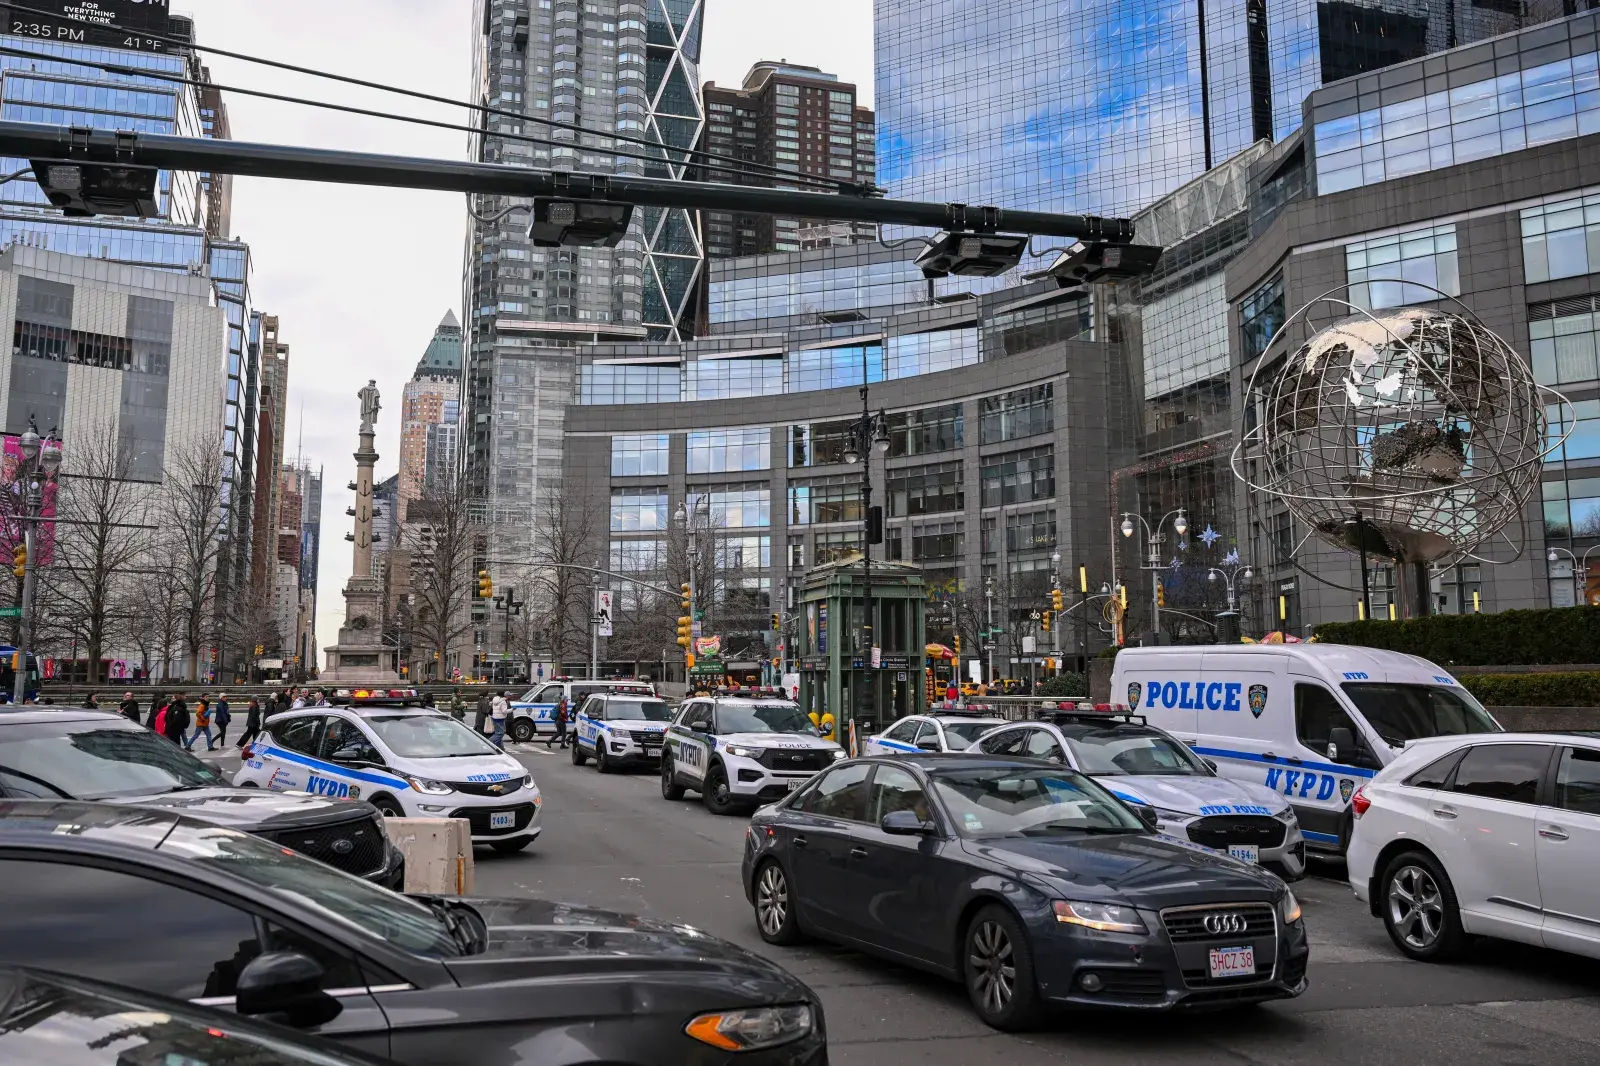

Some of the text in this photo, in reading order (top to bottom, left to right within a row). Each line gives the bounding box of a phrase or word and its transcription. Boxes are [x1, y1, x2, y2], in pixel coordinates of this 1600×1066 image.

[64, 6, 116, 18] EVERYTHING
[68, 13, 111, 24] NEW YORK
[13, 22, 85, 42] 2:35 PM
[123, 37, 140, 48] 41
[1342, 672, 1369, 680] NYPD
[1432, 675, 1454, 684] NYPD
[1146, 681, 1242, 711] POLICE
[680, 741, 698, 766] NYPD
[467, 773, 511, 782] NYPD TRAFFIC
[306, 776, 349, 798] NYPD
[1265, 768, 1336, 800] NYPD
[1199, 805, 1273, 815] NYPD POLICE
[1210, 952, 1253, 970] 3HCZ 38
